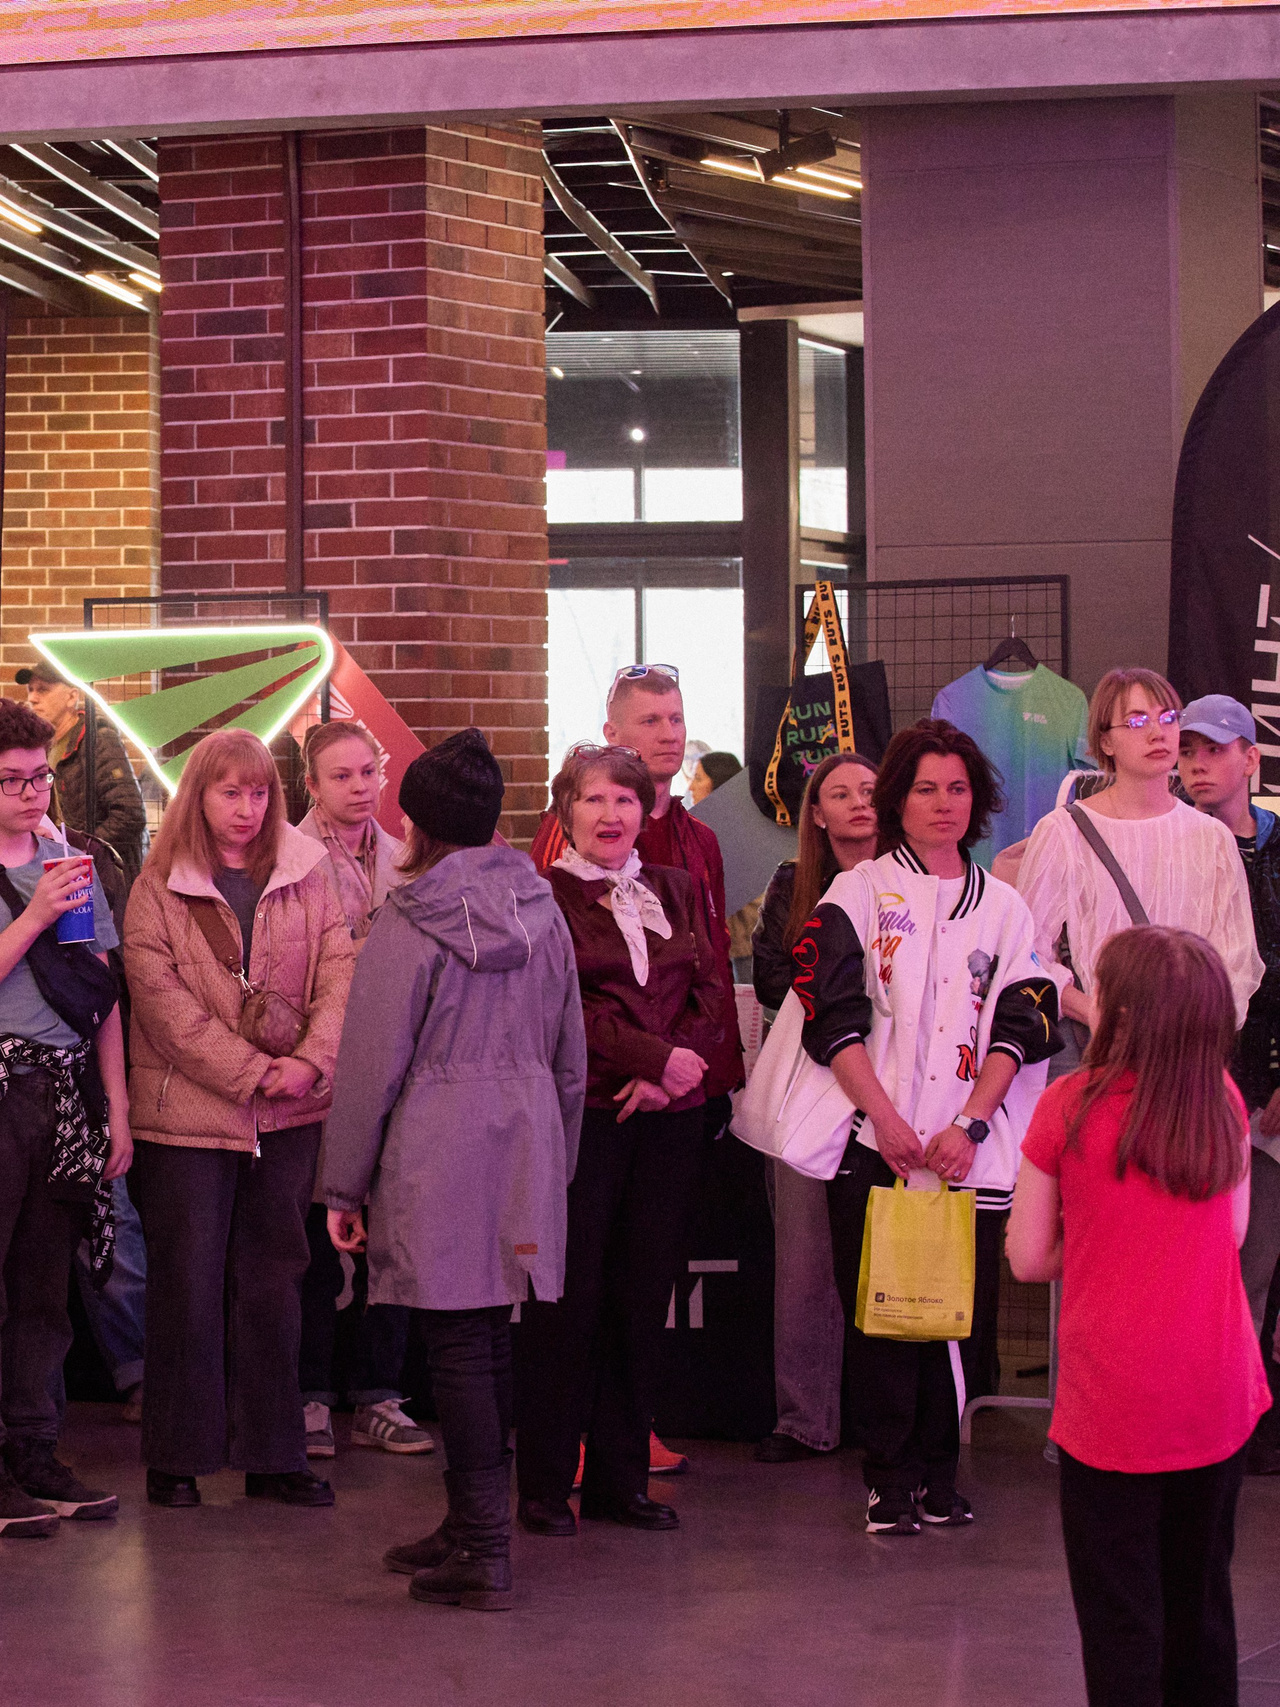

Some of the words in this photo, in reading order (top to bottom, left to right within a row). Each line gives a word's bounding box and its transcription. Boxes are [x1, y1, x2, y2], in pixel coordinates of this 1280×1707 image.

[823, 610, 838, 646] RUTS
[831, 654, 846, 692] RUTS
[838, 699, 850, 737] RUTS
[886, 1294, 917, 1304] Золотое
[917, 1295, 944, 1304] Яблоко
